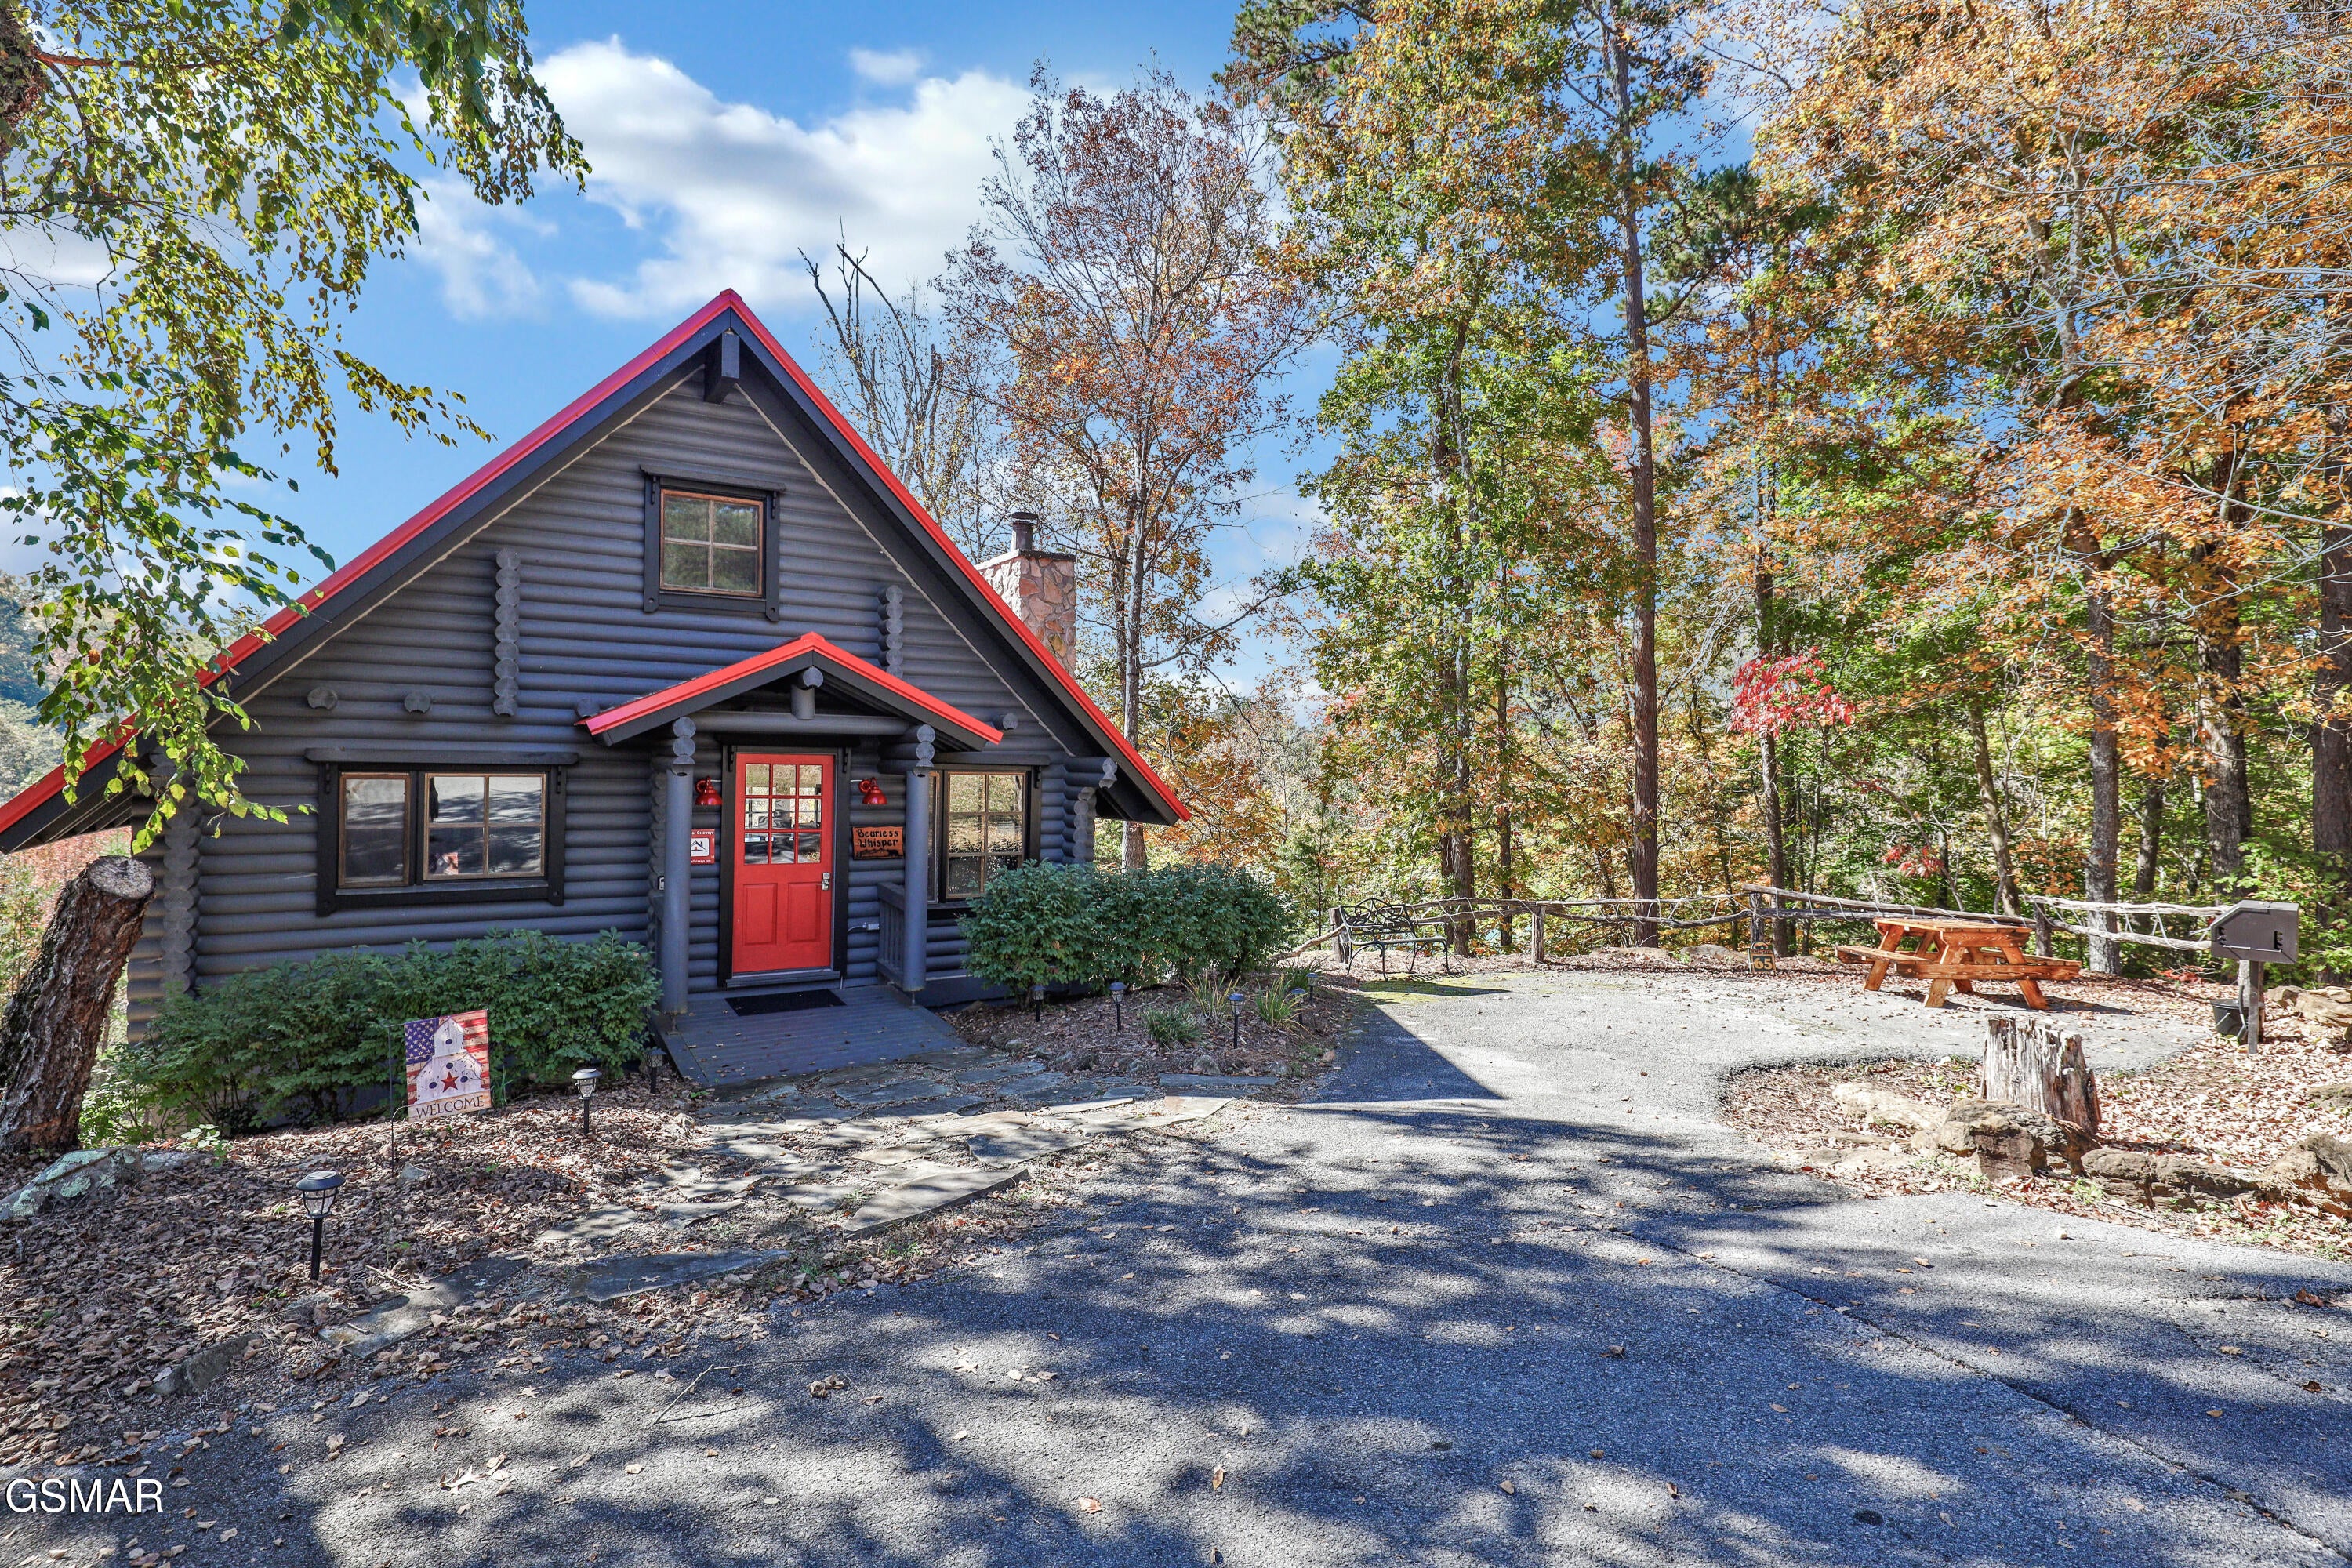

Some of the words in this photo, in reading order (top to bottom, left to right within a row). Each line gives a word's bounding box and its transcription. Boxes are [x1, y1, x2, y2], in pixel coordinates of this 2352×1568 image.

[856, 829, 898, 838] Bearless
[858, 838, 898, 848] Whisper
[1754, 957, 1773, 970] 65
[416, 1095, 485, 1119] WELCOME
